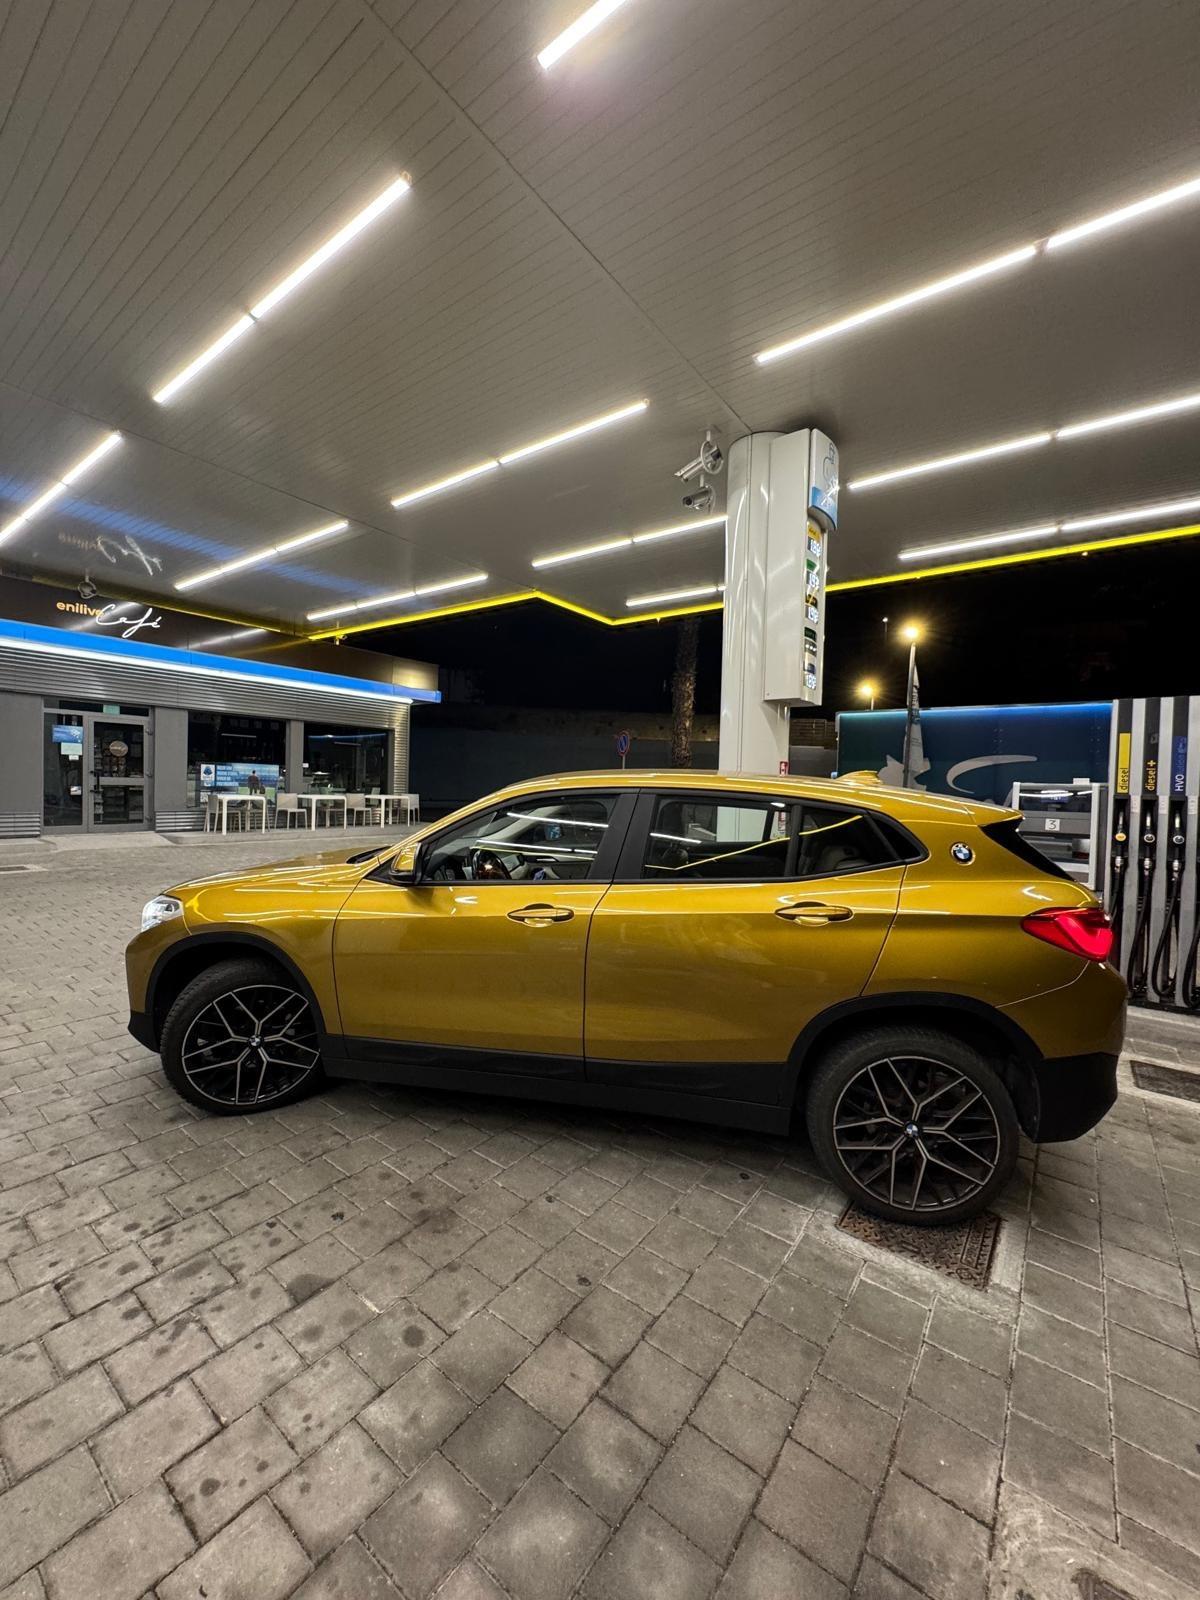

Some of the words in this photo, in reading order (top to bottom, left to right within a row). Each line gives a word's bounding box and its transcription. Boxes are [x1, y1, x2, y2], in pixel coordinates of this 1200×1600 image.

[56, 601, 104, 617] enilive
[96, 603, 162, 639] Café
[1119, 767, 1129, 791] diesel
[1048, 819, 1057, 830] 3
